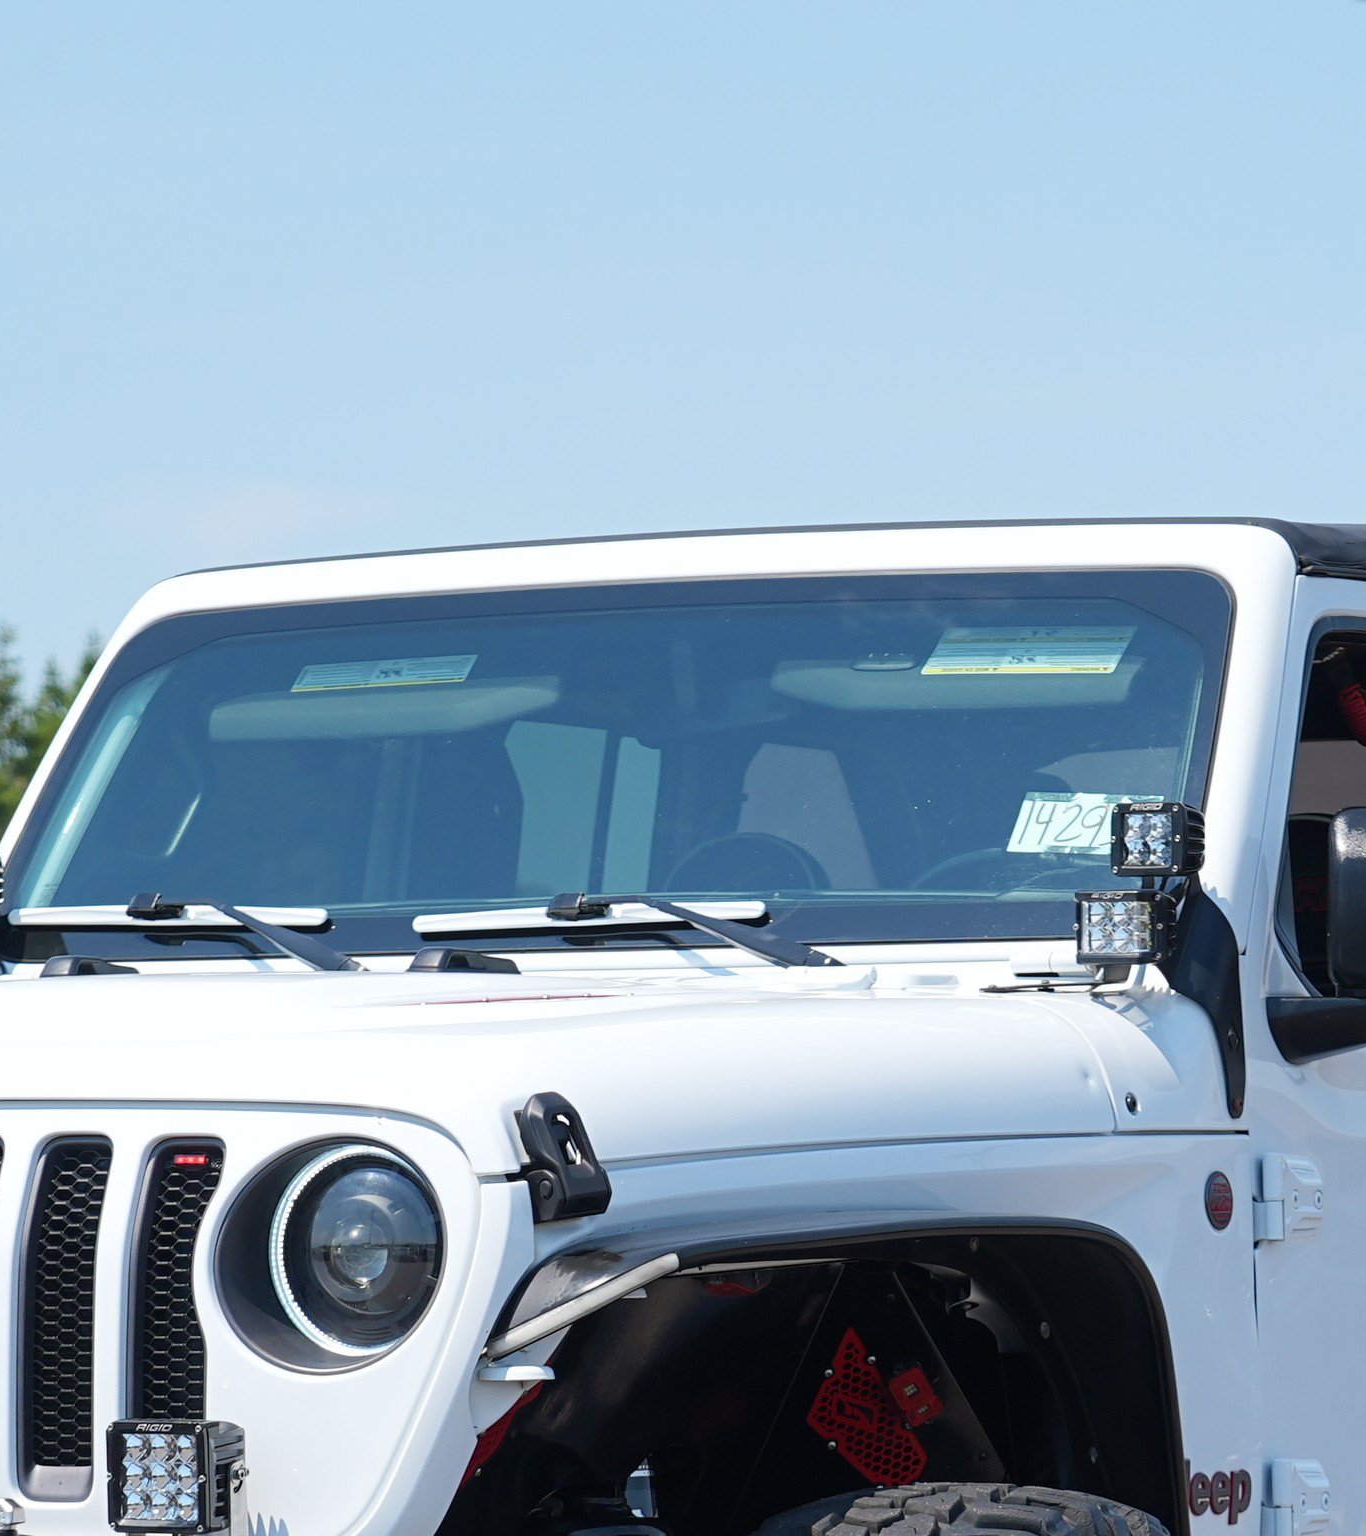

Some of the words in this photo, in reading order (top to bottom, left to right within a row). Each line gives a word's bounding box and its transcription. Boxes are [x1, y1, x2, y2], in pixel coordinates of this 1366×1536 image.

[1129, 802, 1163, 811] RIGID
[1018, 800, 1112, 848] 1429
[135, 1423, 173, 1432] RIGID
[1184, 1459, 1252, 1525] eep
